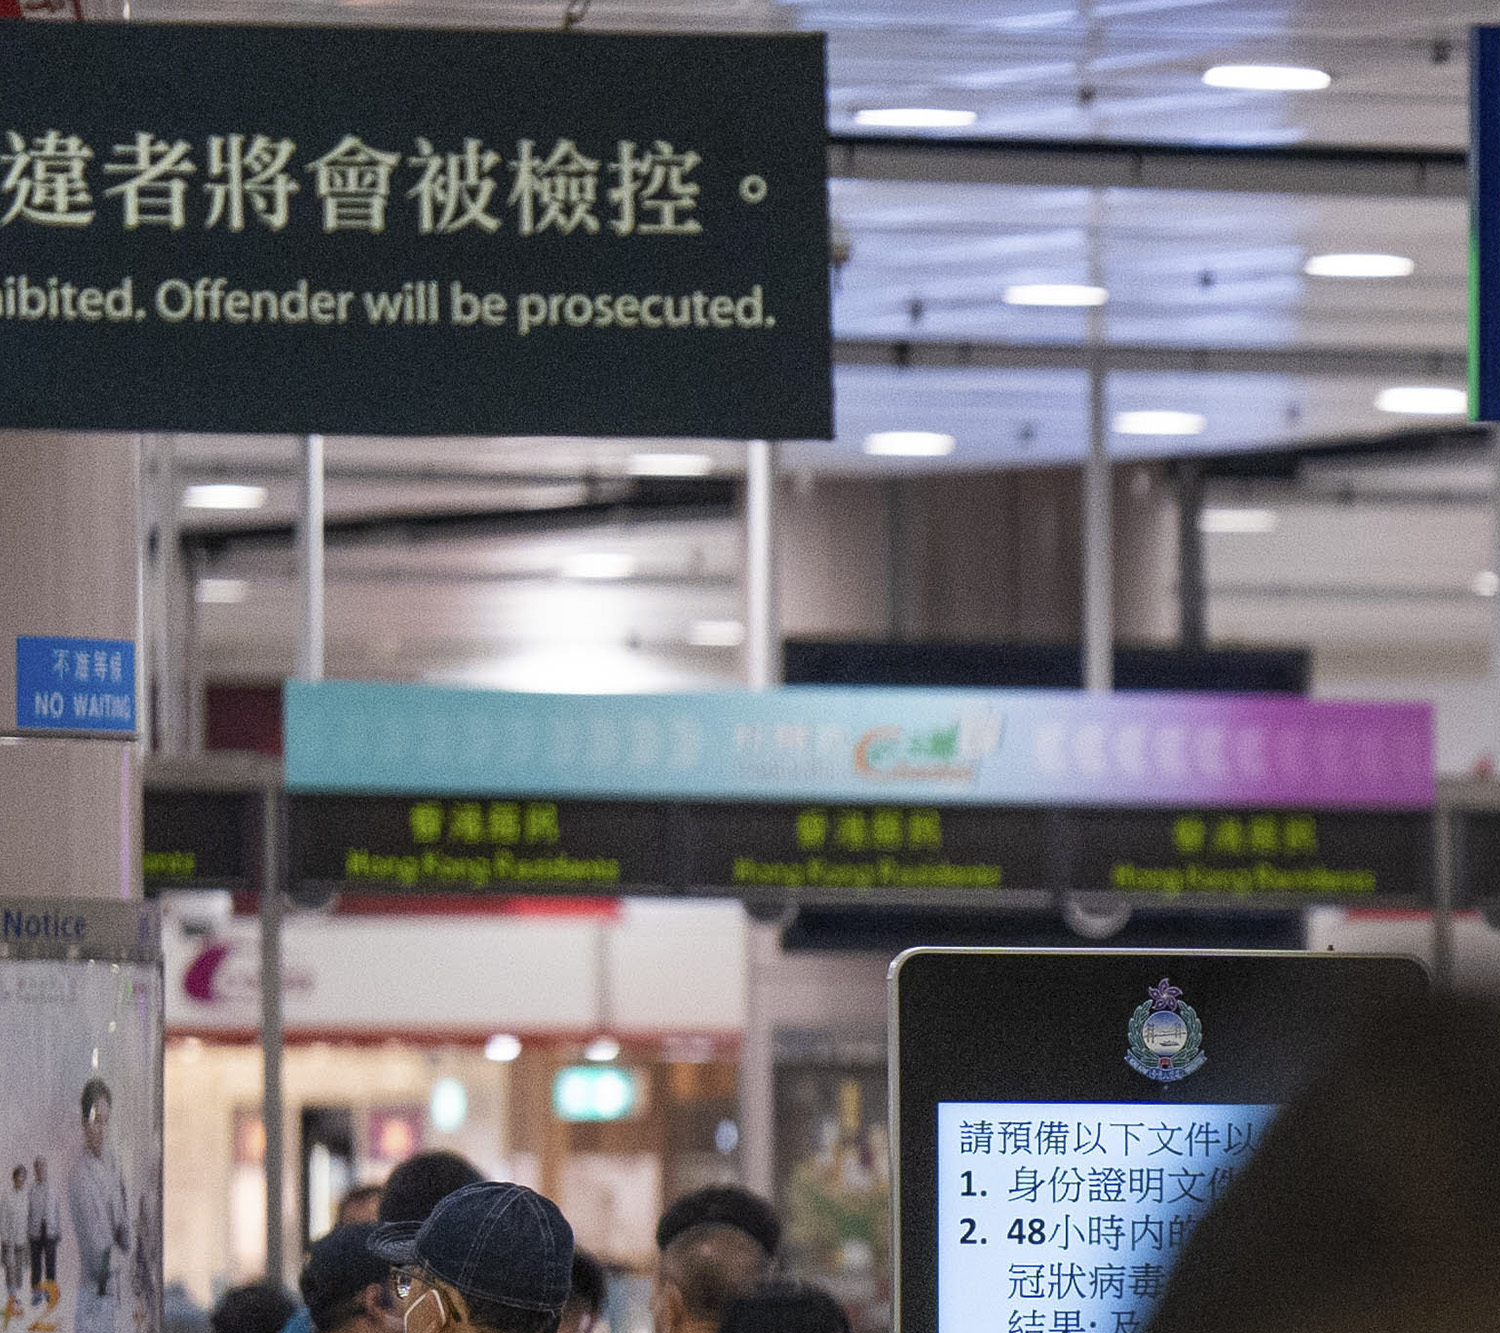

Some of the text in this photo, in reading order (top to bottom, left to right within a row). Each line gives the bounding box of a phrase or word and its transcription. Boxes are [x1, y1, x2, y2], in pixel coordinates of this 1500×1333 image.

[0, 130, 767, 236] 違者將會被檢控。
[156, 278, 355, 326] Offender
[365, 280, 439, 326] will
[451, 282, 506, 328] be
[518, 284, 776, 335] prosecuted.
[33, 690, 132, 720] NO WAITING
[3, 909, 87, 940] Notice
[960, 1170, 987, 1198] 1.
[959, 1217, 987, 1245] 2.
